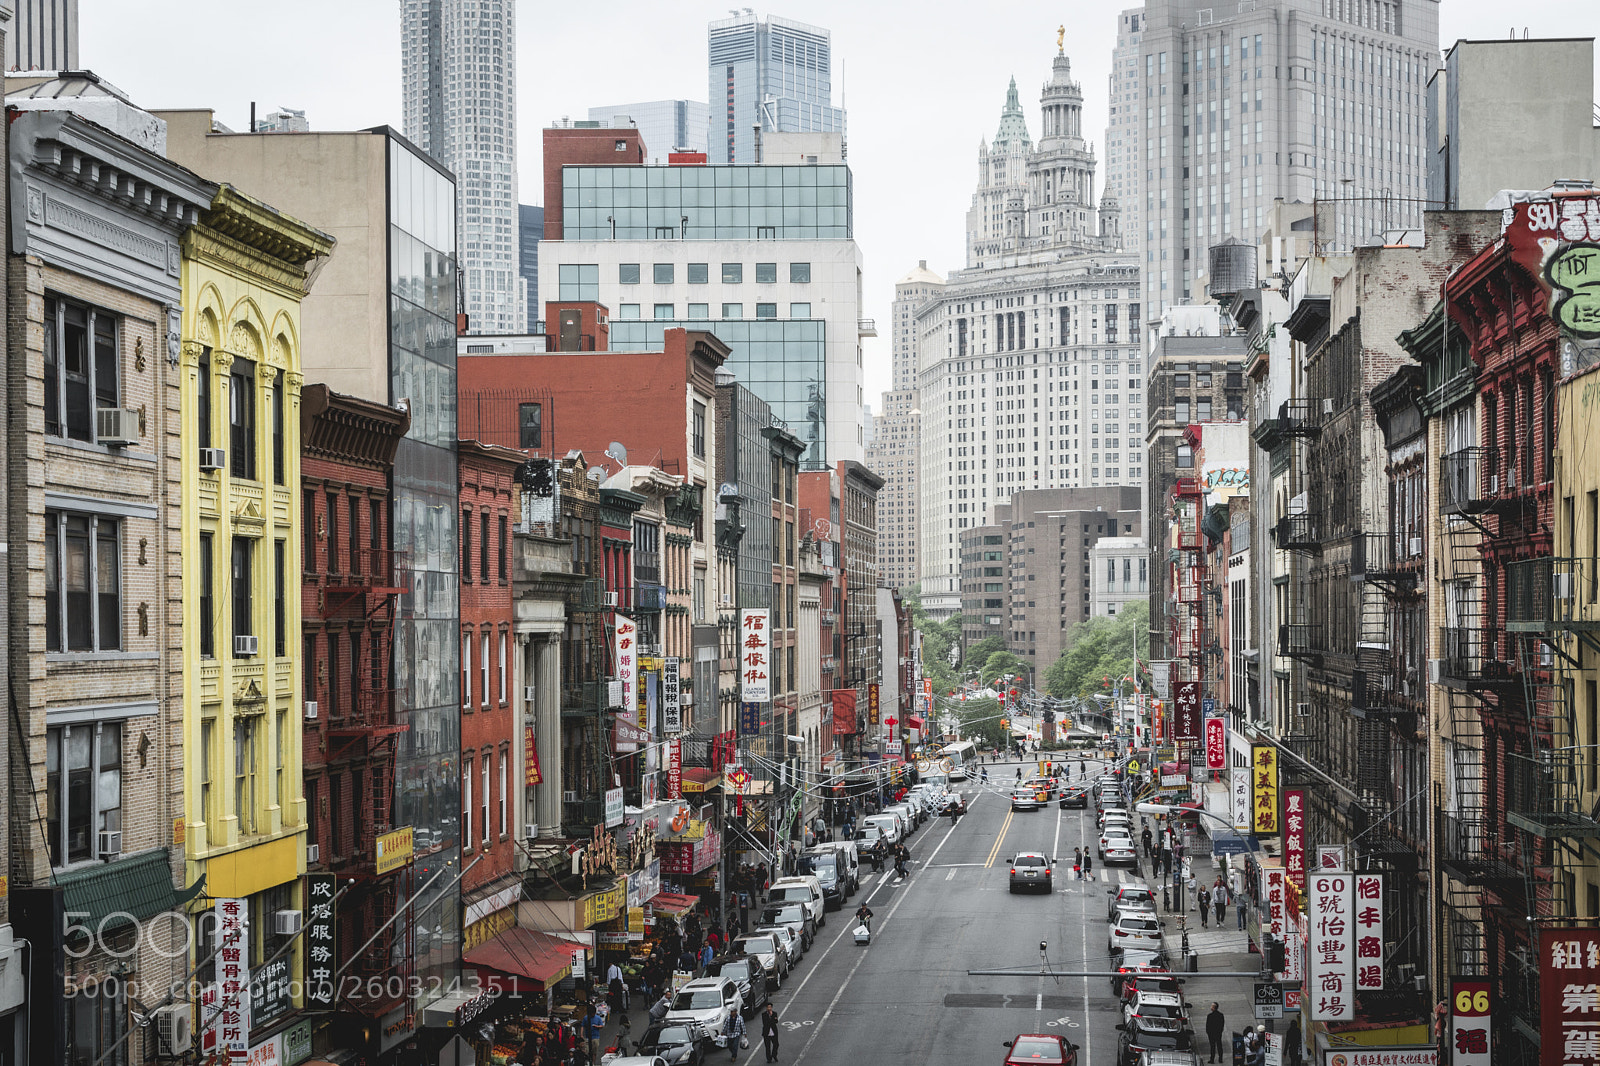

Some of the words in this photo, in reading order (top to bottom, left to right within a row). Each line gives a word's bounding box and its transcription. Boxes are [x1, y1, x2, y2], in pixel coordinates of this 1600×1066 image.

[743, 615, 767, 684] 福華傢俬
[1256, 750, 1275, 830] 華美商場
[1286, 795, 1303, 872] 農家飯莊
[221, 901, 241, 1041] 香港中醫骨傷科診所
[1456, 990, 1490, 1013] 66
[1456, 1028, 1488, 1054] 福
